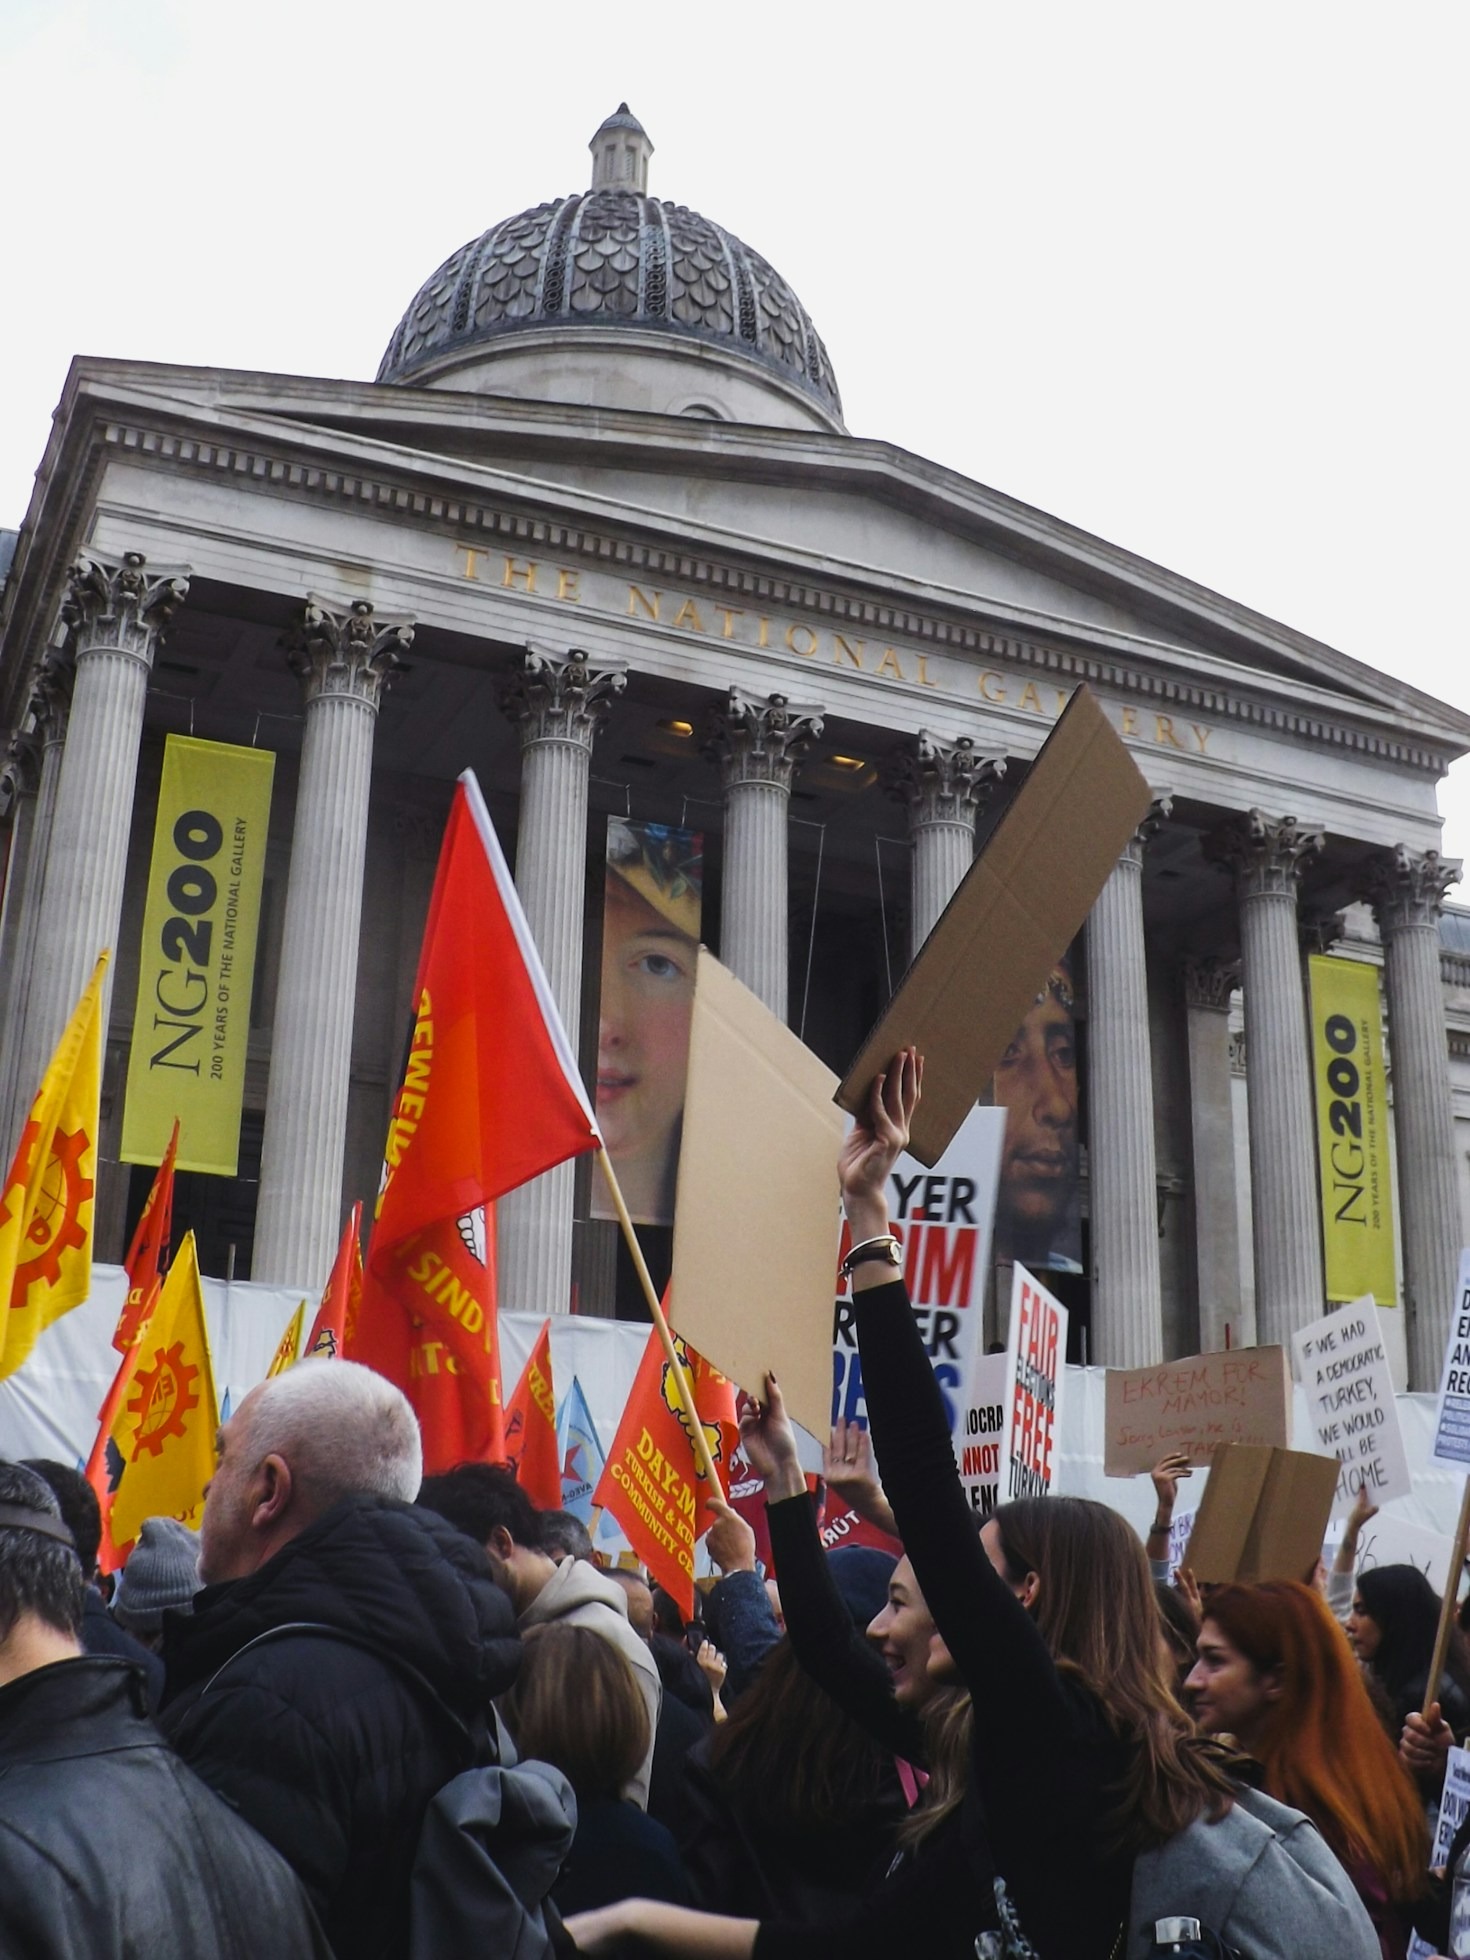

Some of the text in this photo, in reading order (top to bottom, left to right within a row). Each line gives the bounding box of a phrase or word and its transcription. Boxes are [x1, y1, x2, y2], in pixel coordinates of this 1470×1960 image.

[455, 542, 1213, 753] THE NATIONAL GALERY
[150, 809, 223, 1076] NG200
[210, 816, 247, 1080] 200 YEARS OF THE NATIONAL GALLERY
[1361, 1018, 1372, 1067] GALLERY
[1325, 1013, 1367, 1227] NG200
[1365, 1070, 1376, 1126] NATIONAL
[1368, 1128, 1376, 1149] THE
[1370, 1152, 1378, 1168] OF
[890, 1172, 980, 1224] YER
[1371, 1171, 1379, 1207] YEARS
[1017, 1279, 1059, 1382] FAIR
[1302, 1319, 1366, 1360] IF WE HAD
[1122, 1360, 1269, 1405] EKREM FOR
[1316, 1345, 1385, 1386] A DEMOCRATIC
[1161, 1386, 1247, 1415] MAYOR!
[1318, 1376, 1378, 1415] TURKEY,
[1011, 1382, 1055, 1482] FREE
[1317, 1407, 1385, 1446] WE WOULD
[1359, 1433, 1377, 1455] BE
[962, 1443, 1000, 1477] NNOT
[1335, 1457, 1390, 1502] HOME
[624, 1447, 667, 1514] TURKISH
[665, 1507, 676, 1526] &
[610, 1462, 695, 1580] COMMUNITY CE
